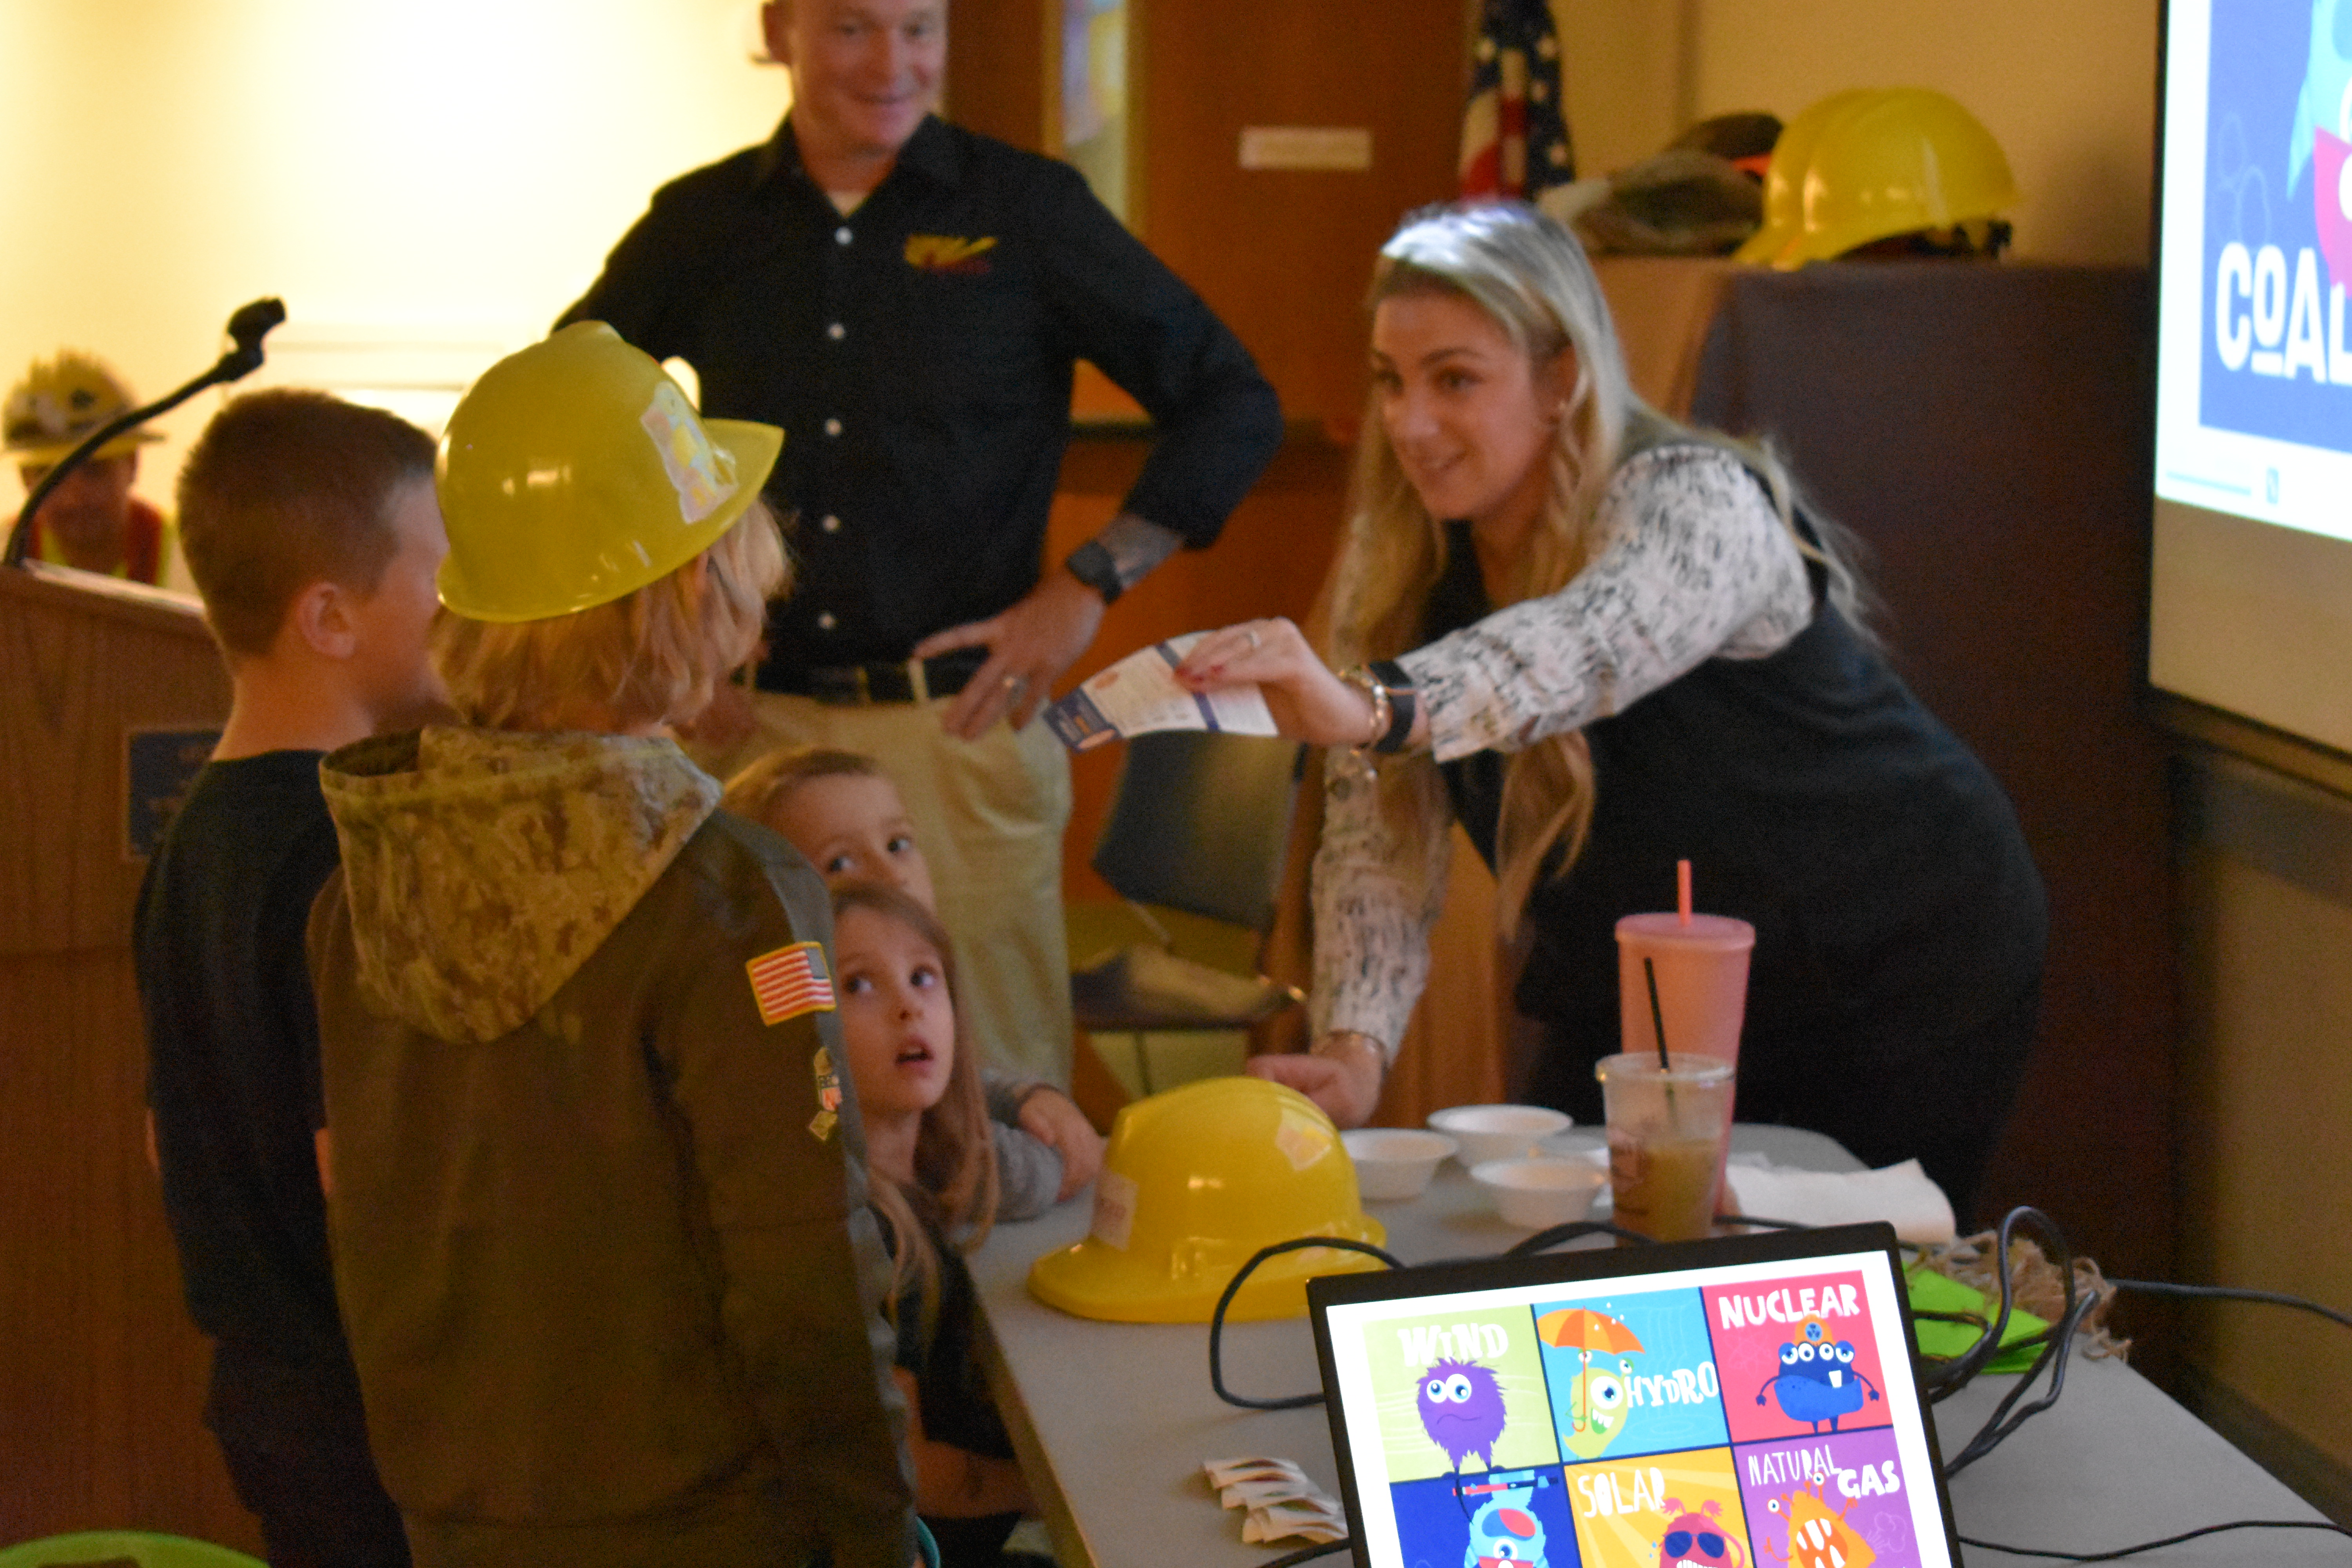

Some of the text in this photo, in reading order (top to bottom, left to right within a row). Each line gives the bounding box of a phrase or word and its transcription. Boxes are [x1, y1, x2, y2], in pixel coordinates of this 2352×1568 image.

[2216, 241, 2352, 387] COAL
[1718, 1284, 1860, 1329] NUCLEAR
[1397, 1322, 1509, 1367] WIND
[1624, 1361, 1720, 1408] HYDRO
[1577, 1466, 1666, 1518] SOLAR
[1748, 1444, 1900, 1499] NATURAL GAS
